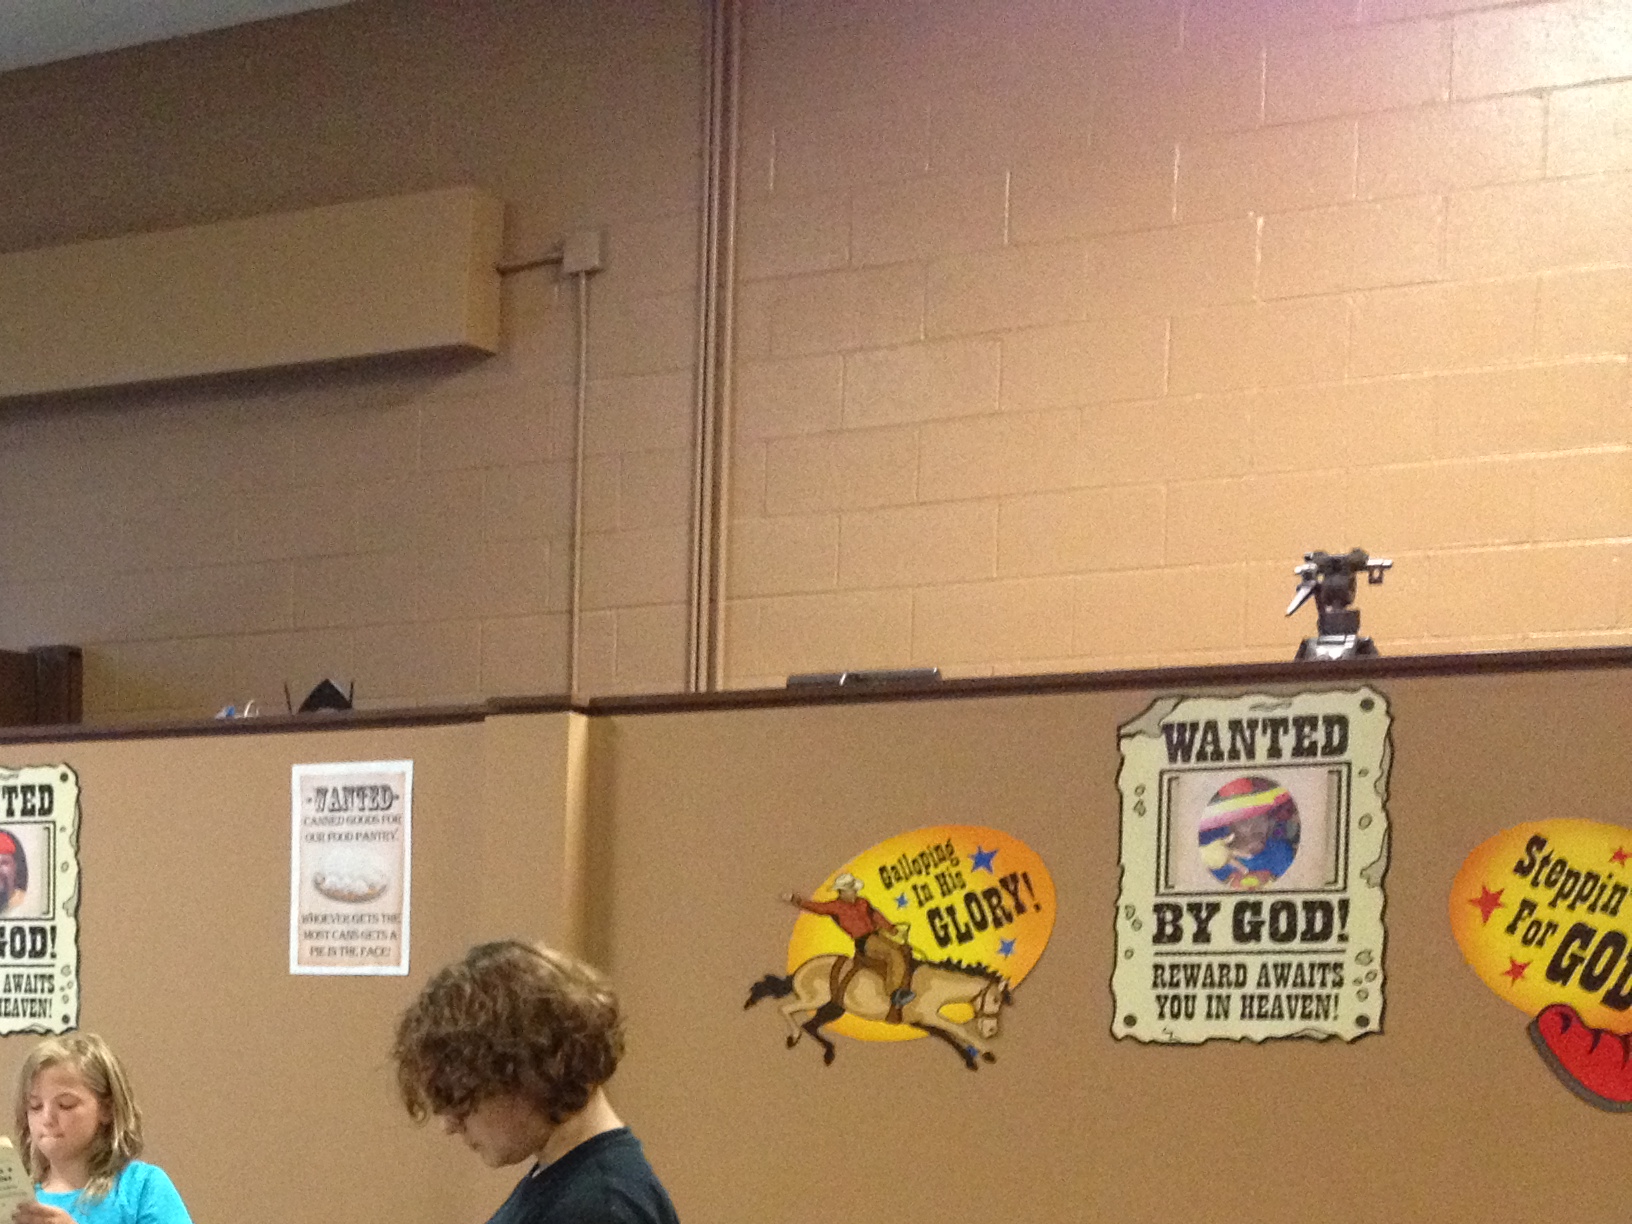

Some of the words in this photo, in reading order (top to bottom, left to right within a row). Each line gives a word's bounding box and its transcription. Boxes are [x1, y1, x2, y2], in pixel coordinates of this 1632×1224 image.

[1160, 715, 1350, 763] WANTED
[314, 784, 394, 813] WANTED
[878, 837, 961, 890] Galloping
[912, 882, 935, 908] In
[935, 870, 967, 900] His
[926, 871, 1042, 948] GLORY!
[1152, 901, 1221, 944] BY
[1232, 897, 1350, 944] GOD!
[1504, 898, 1560, 948] For
[389, 930, 398, 941] A
[3, 973, 55, 995] AWAITS
[1152, 963, 1248, 989] REWARD
[1256, 961, 1345, 989] AWAITS
[1156, 994, 1197, 1020] YOU
[1205, 993, 1232, 1020] IN
[1240, 993, 1340, 1020] HEAVEN!
